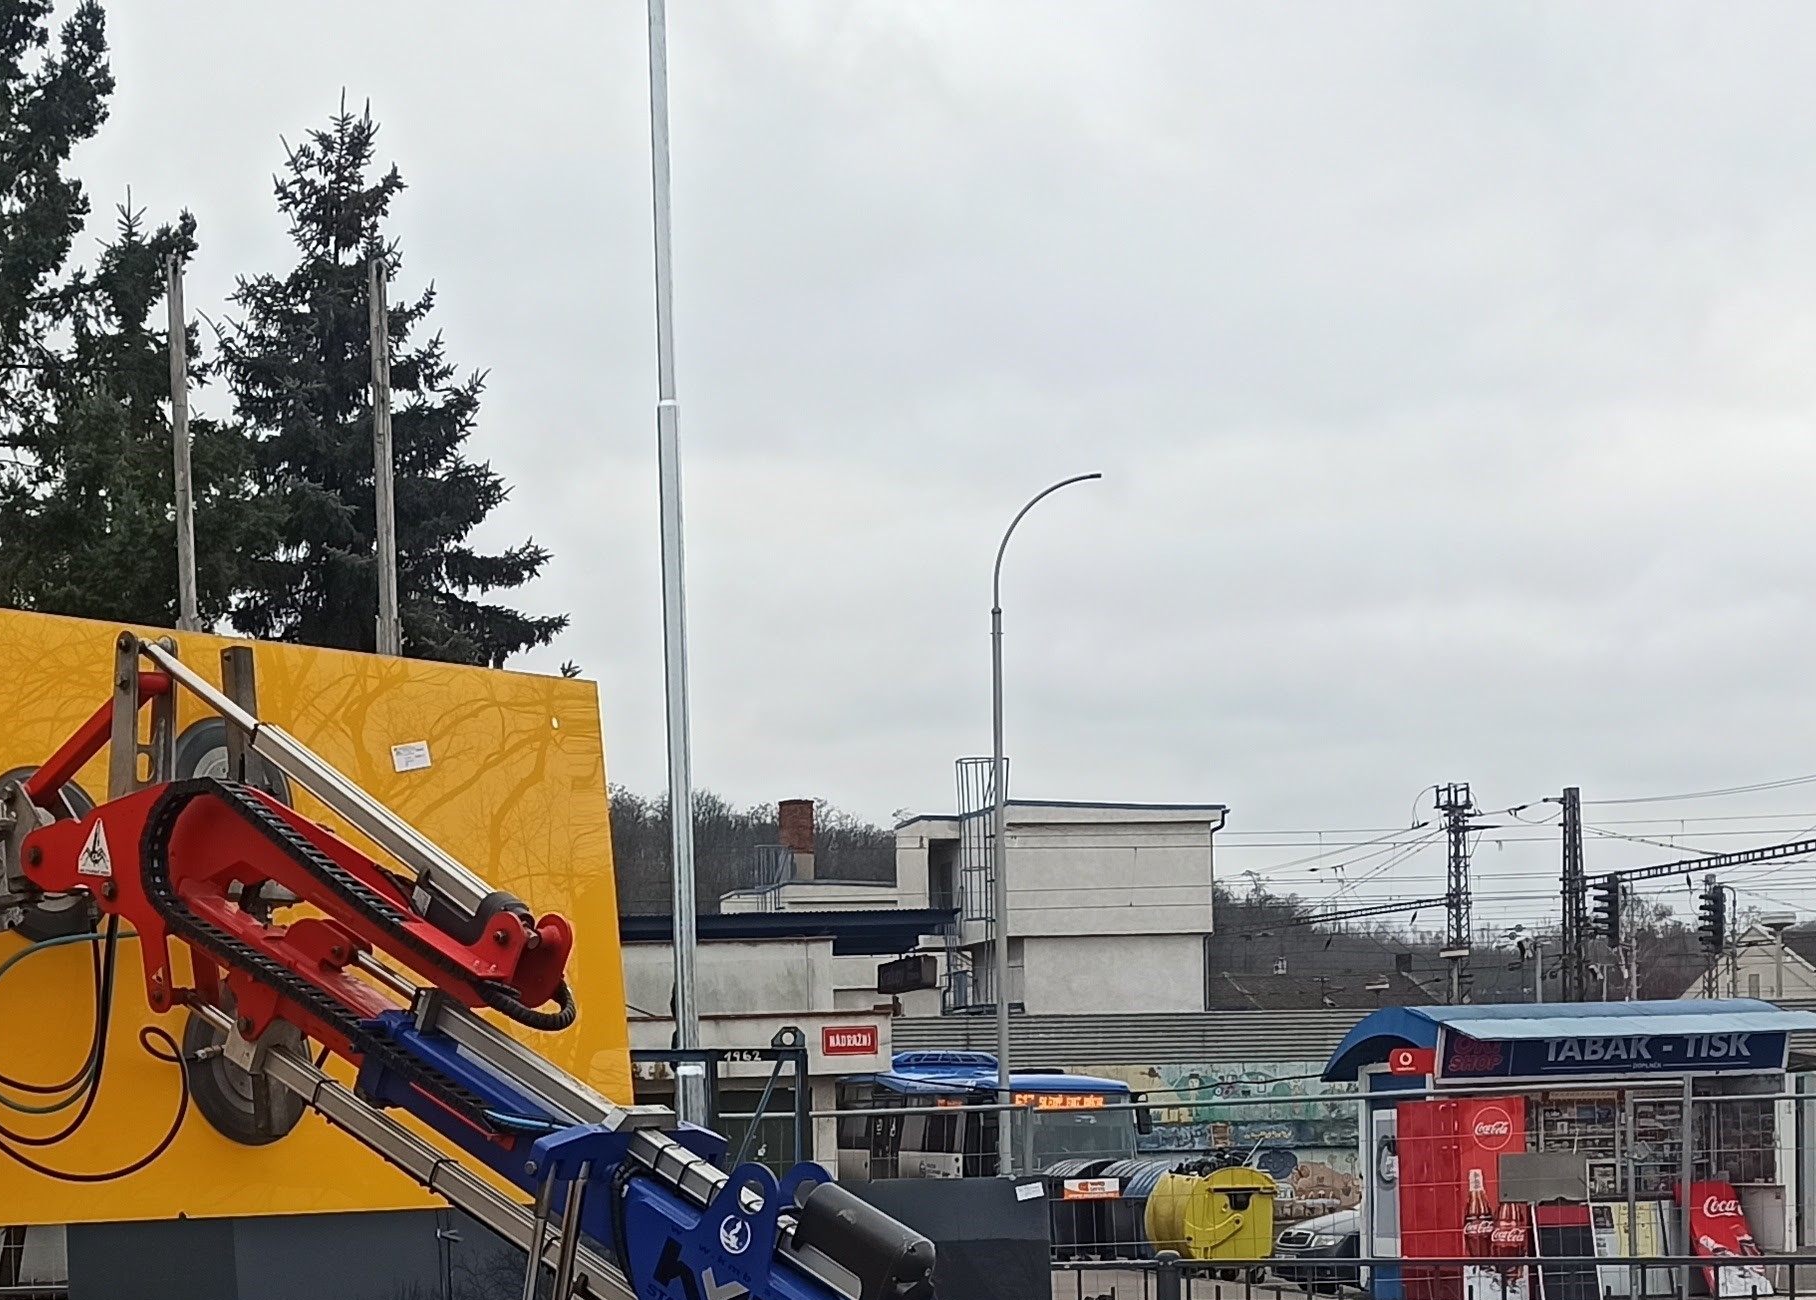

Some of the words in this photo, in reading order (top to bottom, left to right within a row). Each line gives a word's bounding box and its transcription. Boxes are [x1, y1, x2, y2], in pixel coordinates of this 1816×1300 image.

[829, 1032, 872, 1047] NÁDRAŽNÍ
[1683, 1033, 1752, 1058] TISK
[724, 1051, 762, 1062] 1962
